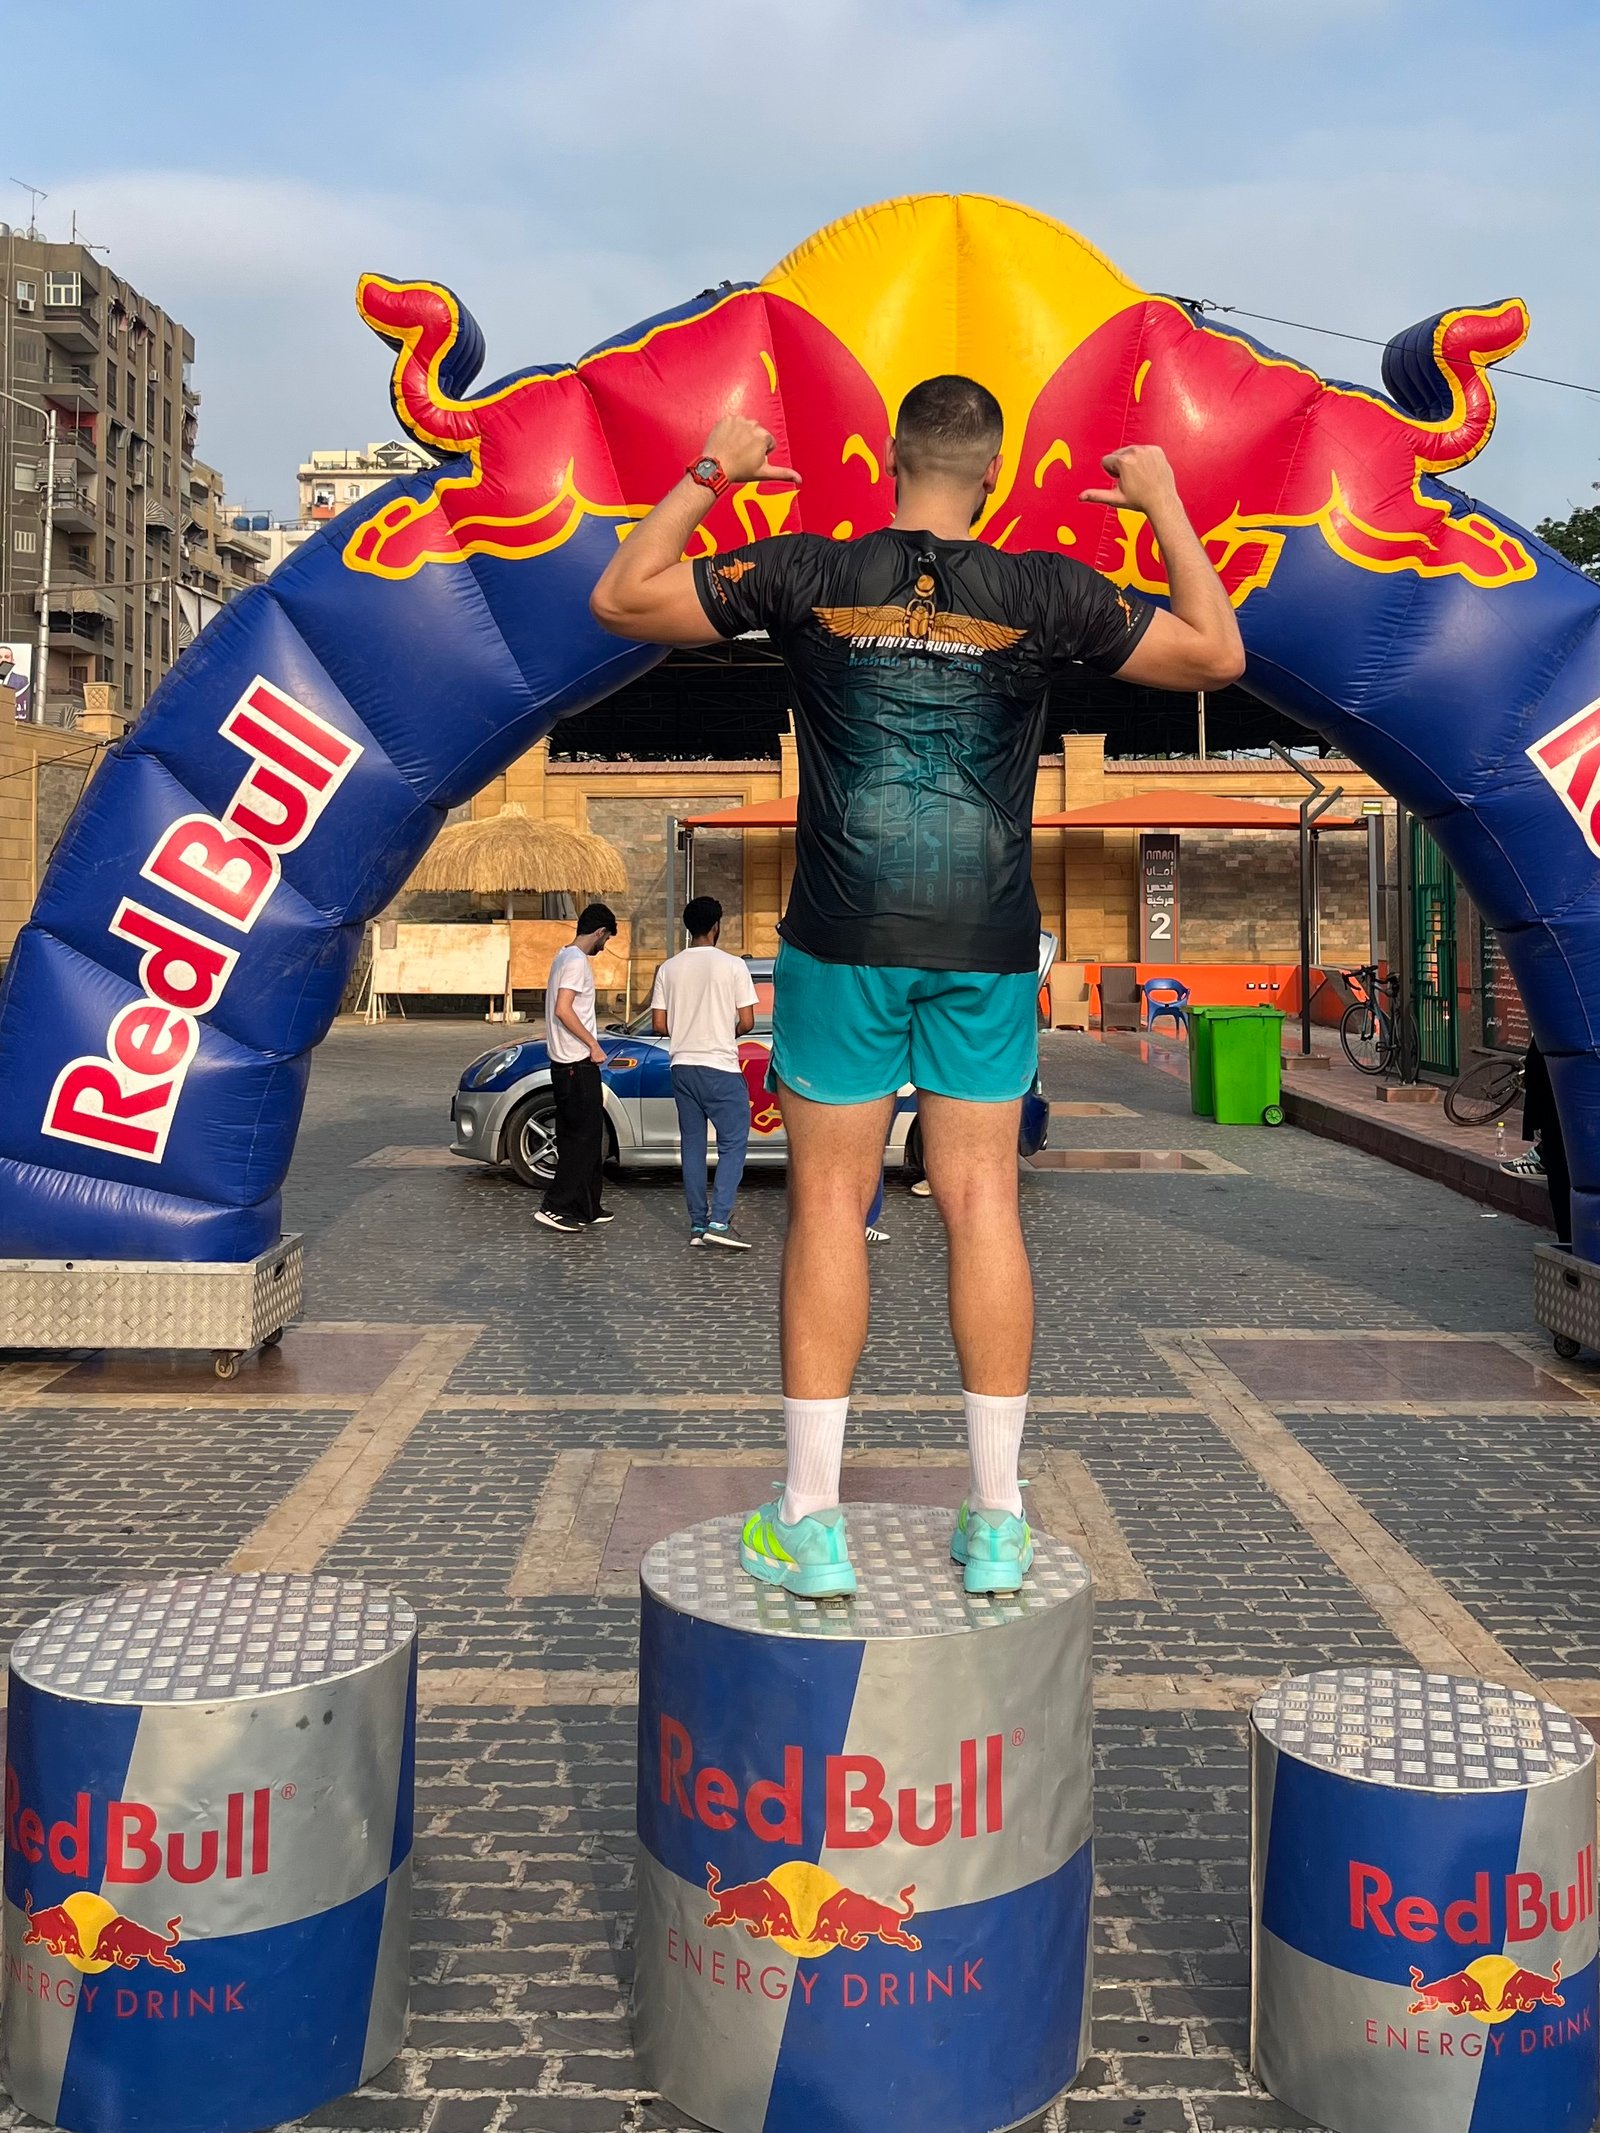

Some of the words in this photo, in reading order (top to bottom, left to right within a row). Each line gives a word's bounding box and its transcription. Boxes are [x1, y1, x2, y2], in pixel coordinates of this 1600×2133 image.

[849, 636, 875, 649] FAT
[876, 636, 923, 650] UNITED
[925, 640, 985, 656] RUNNERS
[46, 903, 232, 1158] Red
[147, 680, 356, 926] Bull
[1150, 912, 1171, 940] 2
[658, 1712, 803, 1845] Red
[825, 1733, 1003, 1849] Bull
[105, 1787, 271, 1884] Bull
[1349, 1860, 1491, 1944] Red
[1505, 1840, 1593, 1943] Bull
[116, 1980, 247, 2020] DRINK
[667, 1927, 820, 2006] ENERGY
[843, 1957, 985, 2008] DRINK
[1365, 2018, 1505, 2057] ENERGY
[1520, 2005, 1592, 2054] DRINK
